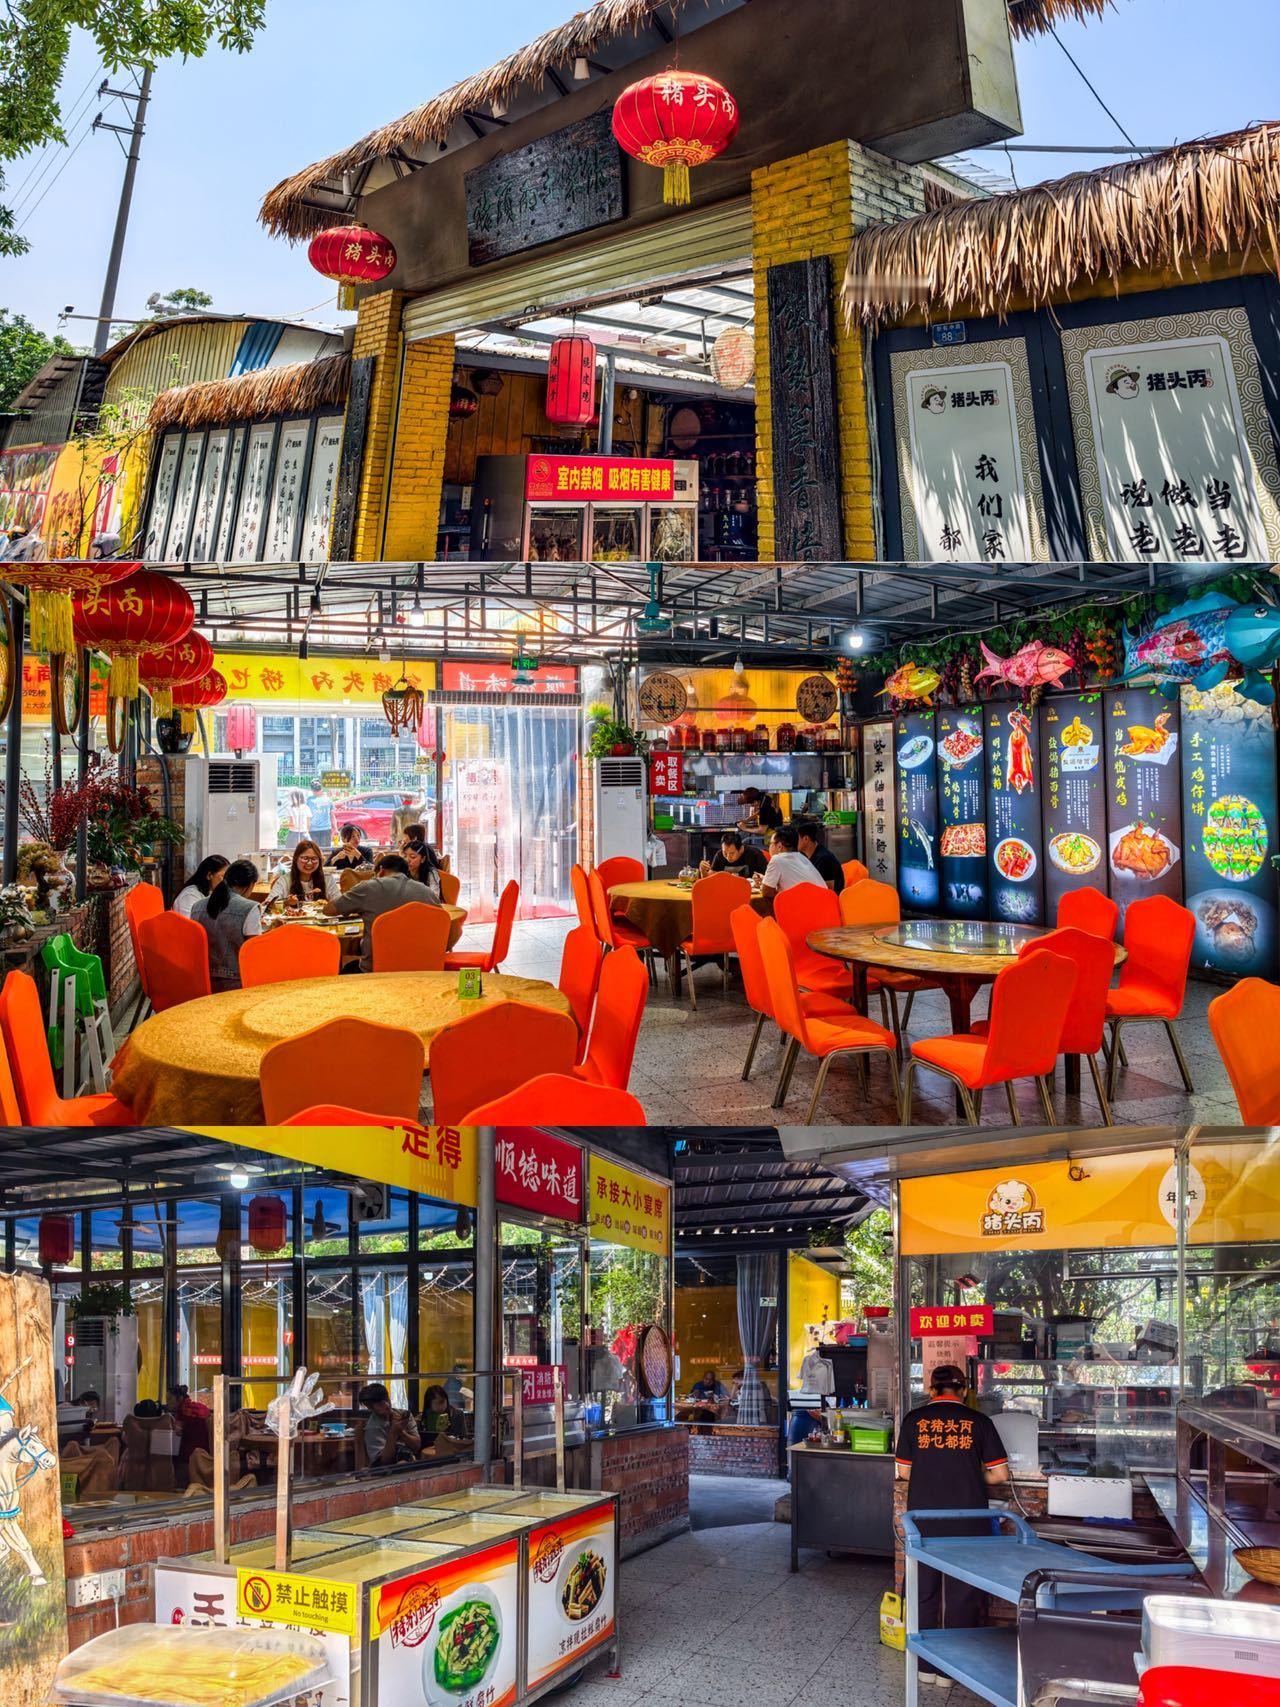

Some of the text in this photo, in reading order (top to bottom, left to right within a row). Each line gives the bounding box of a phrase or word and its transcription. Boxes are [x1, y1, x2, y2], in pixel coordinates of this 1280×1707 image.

[660, 78, 735, 120] 猪头丙
[344, 242, 395, 268] 猪头丙
[1147, 369, 1206, 391] 猪头丙
[951, 390, 994, 408] 猪头丙
[557, 465, 603, 491] 室内禁烟
[609, 468, 671, 491] 吸烟有害健康
[976, 454, 1005, 559] 我们家
[74, 587, 143, 616] 头丙
[655, 760, 666, 786] 外卖
[667, 756, 678, 791] 取餐区
[496, 1139, 579, 1206] 顺德味道
[597, 1176, 663, 1219] 承接大小宴席
[984, 1210, 1042, 1231] 猪头丙
[919, 1314, 984, 1328] 欢迎外卖
[67, 1336, 74, 1345] 9
[916, 1419, 974, 1433] 食猪头丙
[276, 1583, 348, 1615] 禁止触摸
[302, 1611, 328, 1623] touching
